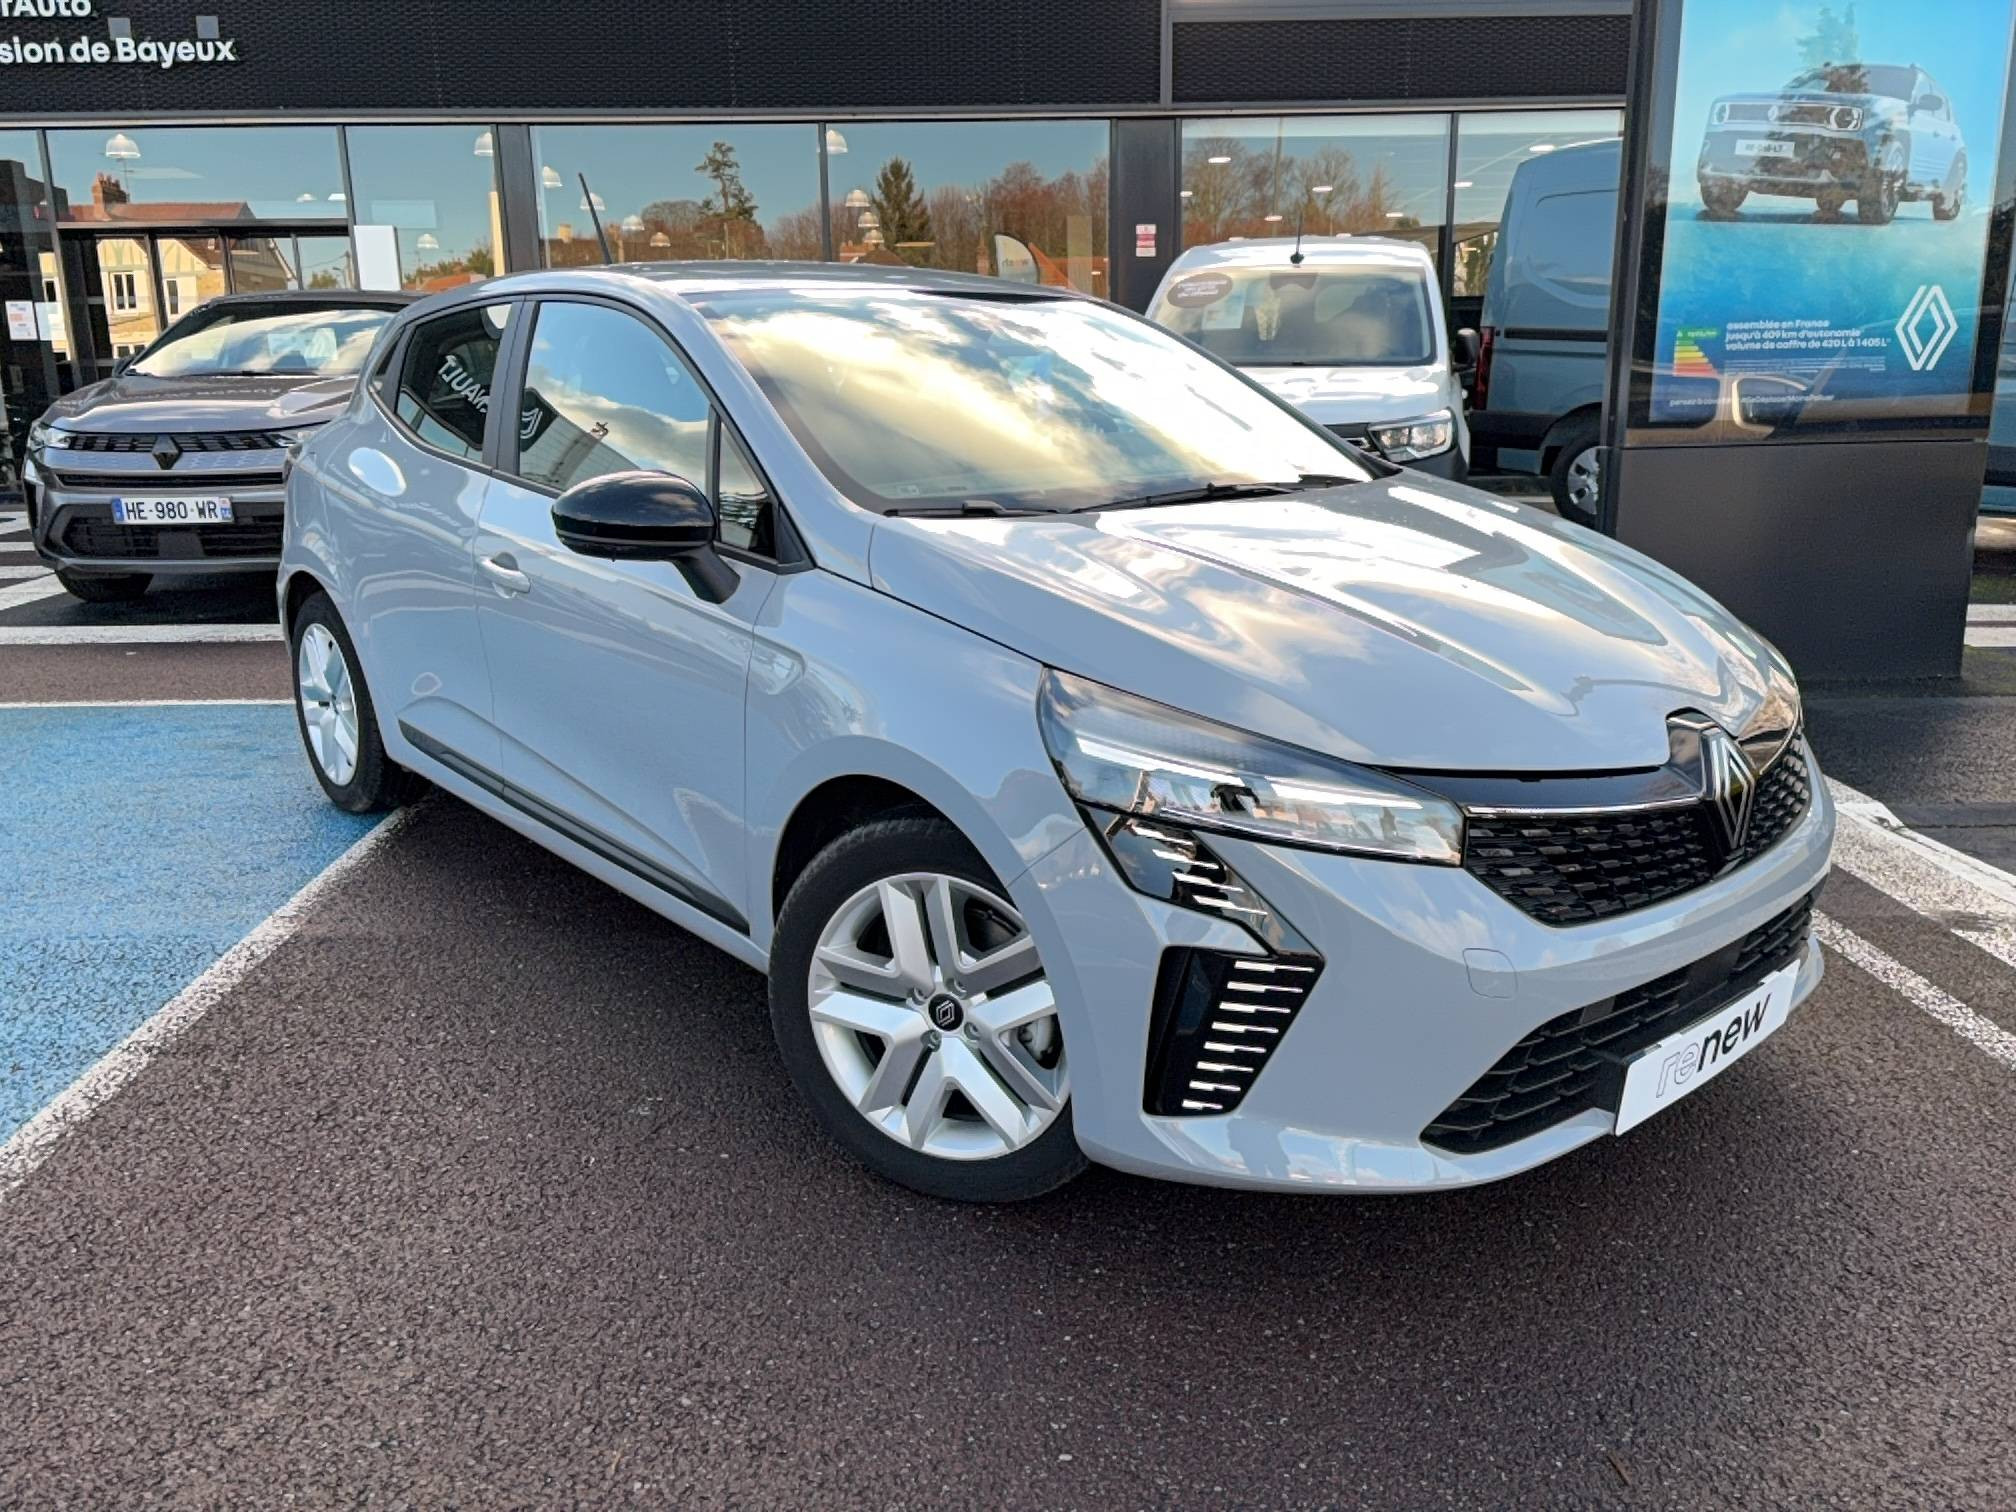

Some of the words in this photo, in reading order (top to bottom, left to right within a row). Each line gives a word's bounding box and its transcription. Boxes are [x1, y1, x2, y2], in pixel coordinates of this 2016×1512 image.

[0, 35, 65, 63] sion
[69, 35, 110, 63] de
[115, 37, 236, 69] Bayeux
[124, 500, 219, 520] HE-980-WR
[1656, 992, 1772, 1098] renew
